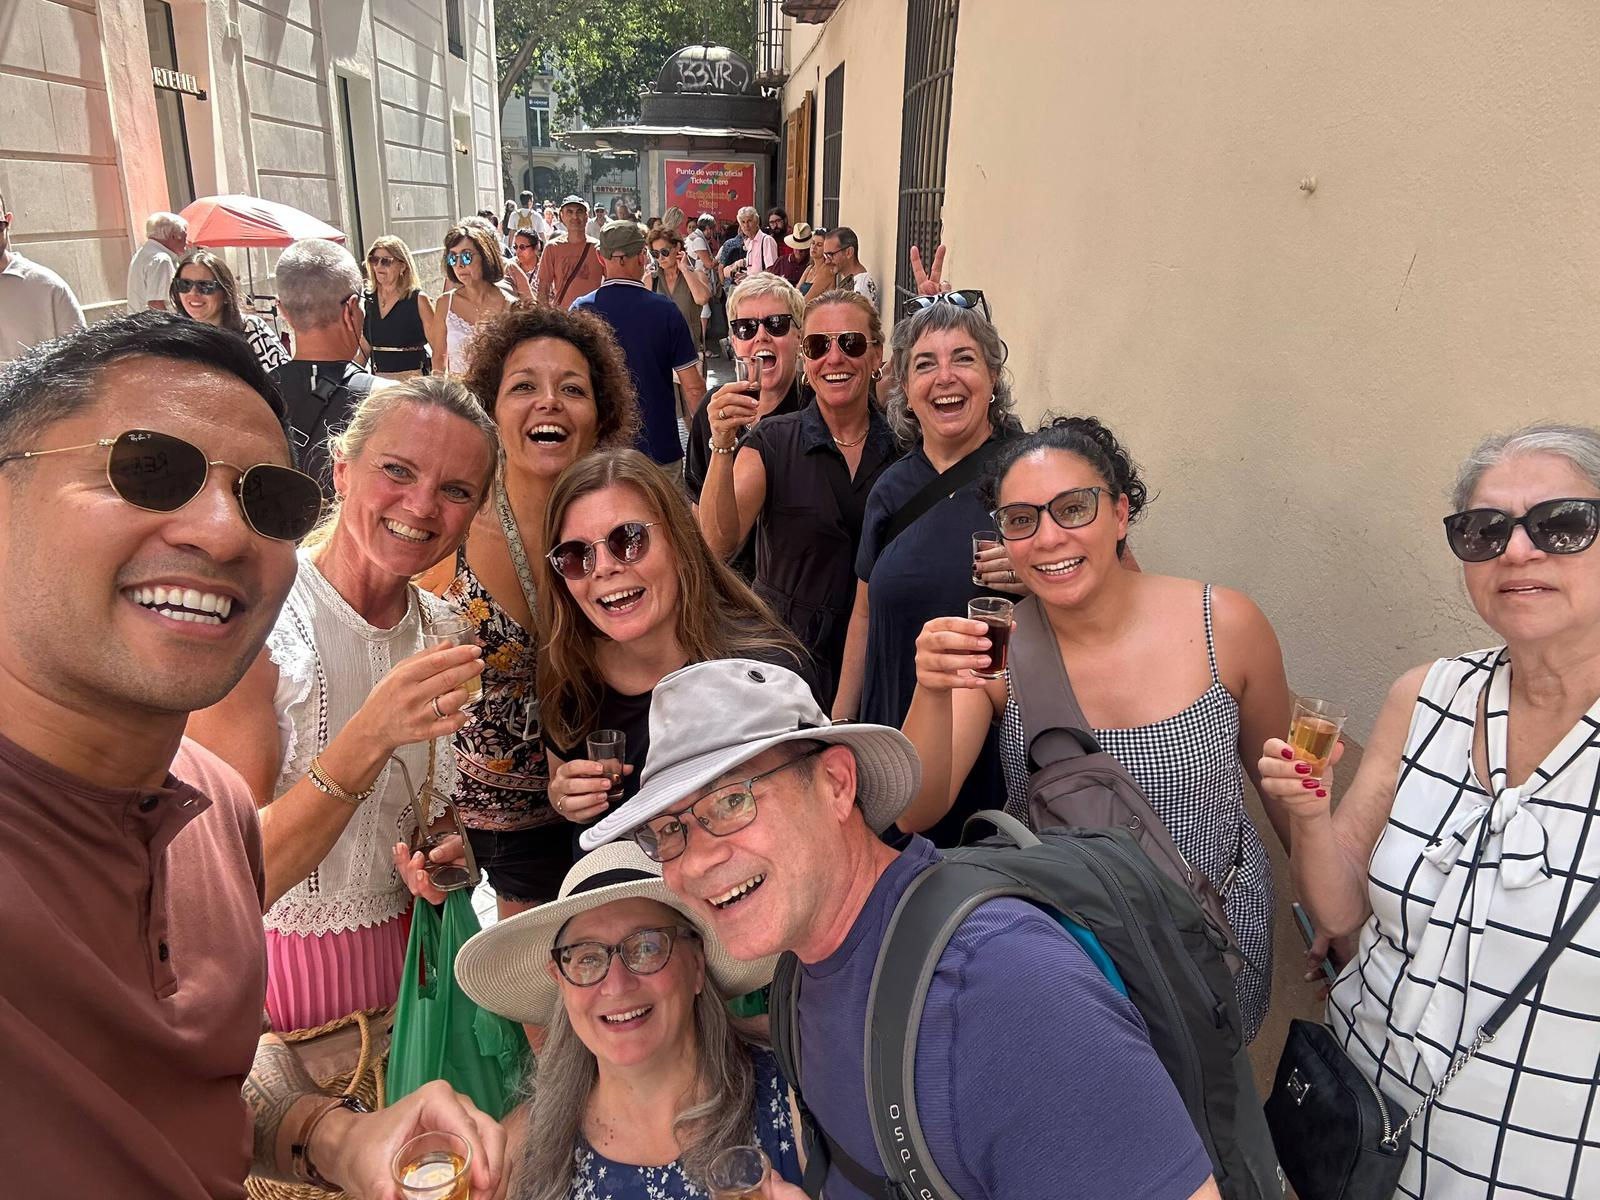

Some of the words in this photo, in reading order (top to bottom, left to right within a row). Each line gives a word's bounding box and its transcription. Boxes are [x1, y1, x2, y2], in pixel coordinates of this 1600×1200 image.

[676, 167, 695, 176] Punto
[690, 177, 713, 185] Tickets
[714, 178, 728, 186] here
